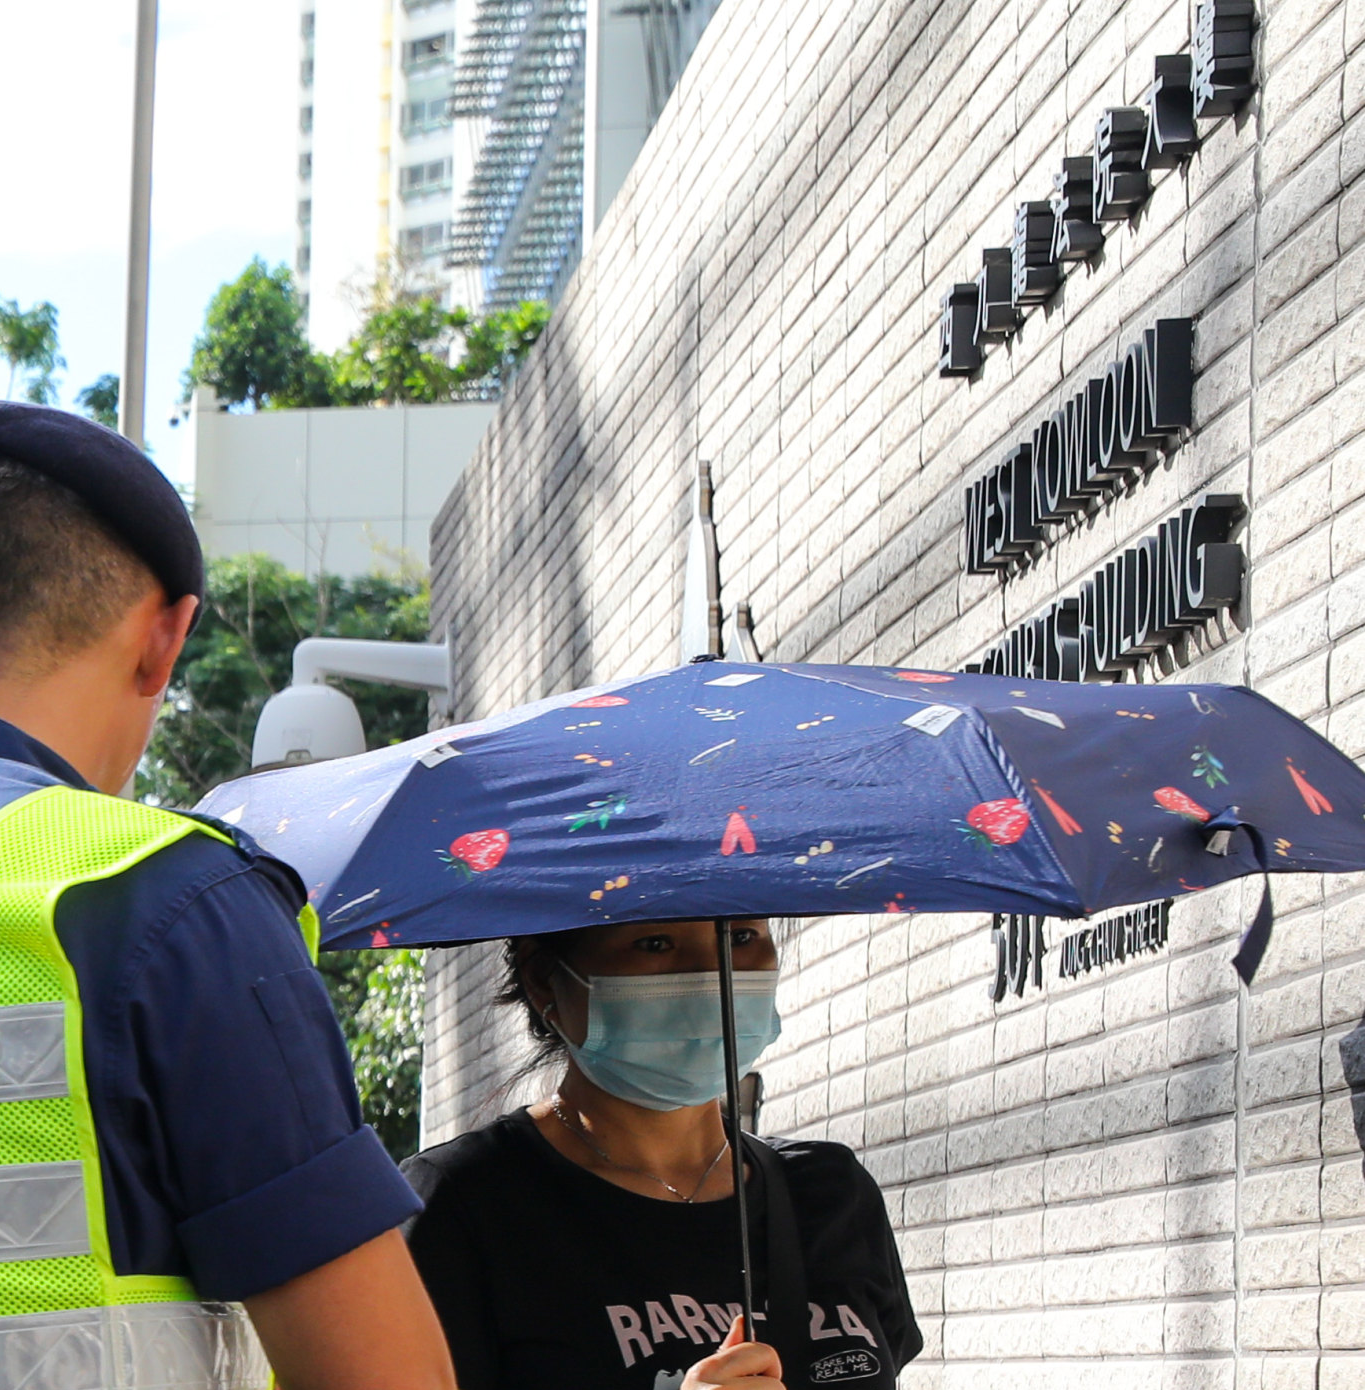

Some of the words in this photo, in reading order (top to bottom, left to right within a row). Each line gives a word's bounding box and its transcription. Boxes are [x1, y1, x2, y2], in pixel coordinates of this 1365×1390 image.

[963, 444, 1021, 574] WEST
[1031, 319, 1160, 526] KOWLOON
[1079, 494, 1207, 682] BUILDING
[1123, 898, 1165, 955] STREET
[814, 1357, 845, 1371] RARE
[846, 1353, 869, 1364] AND
[816, 1366, 849, 1379] REAL
[853, 1362, 872, 1372] ME
